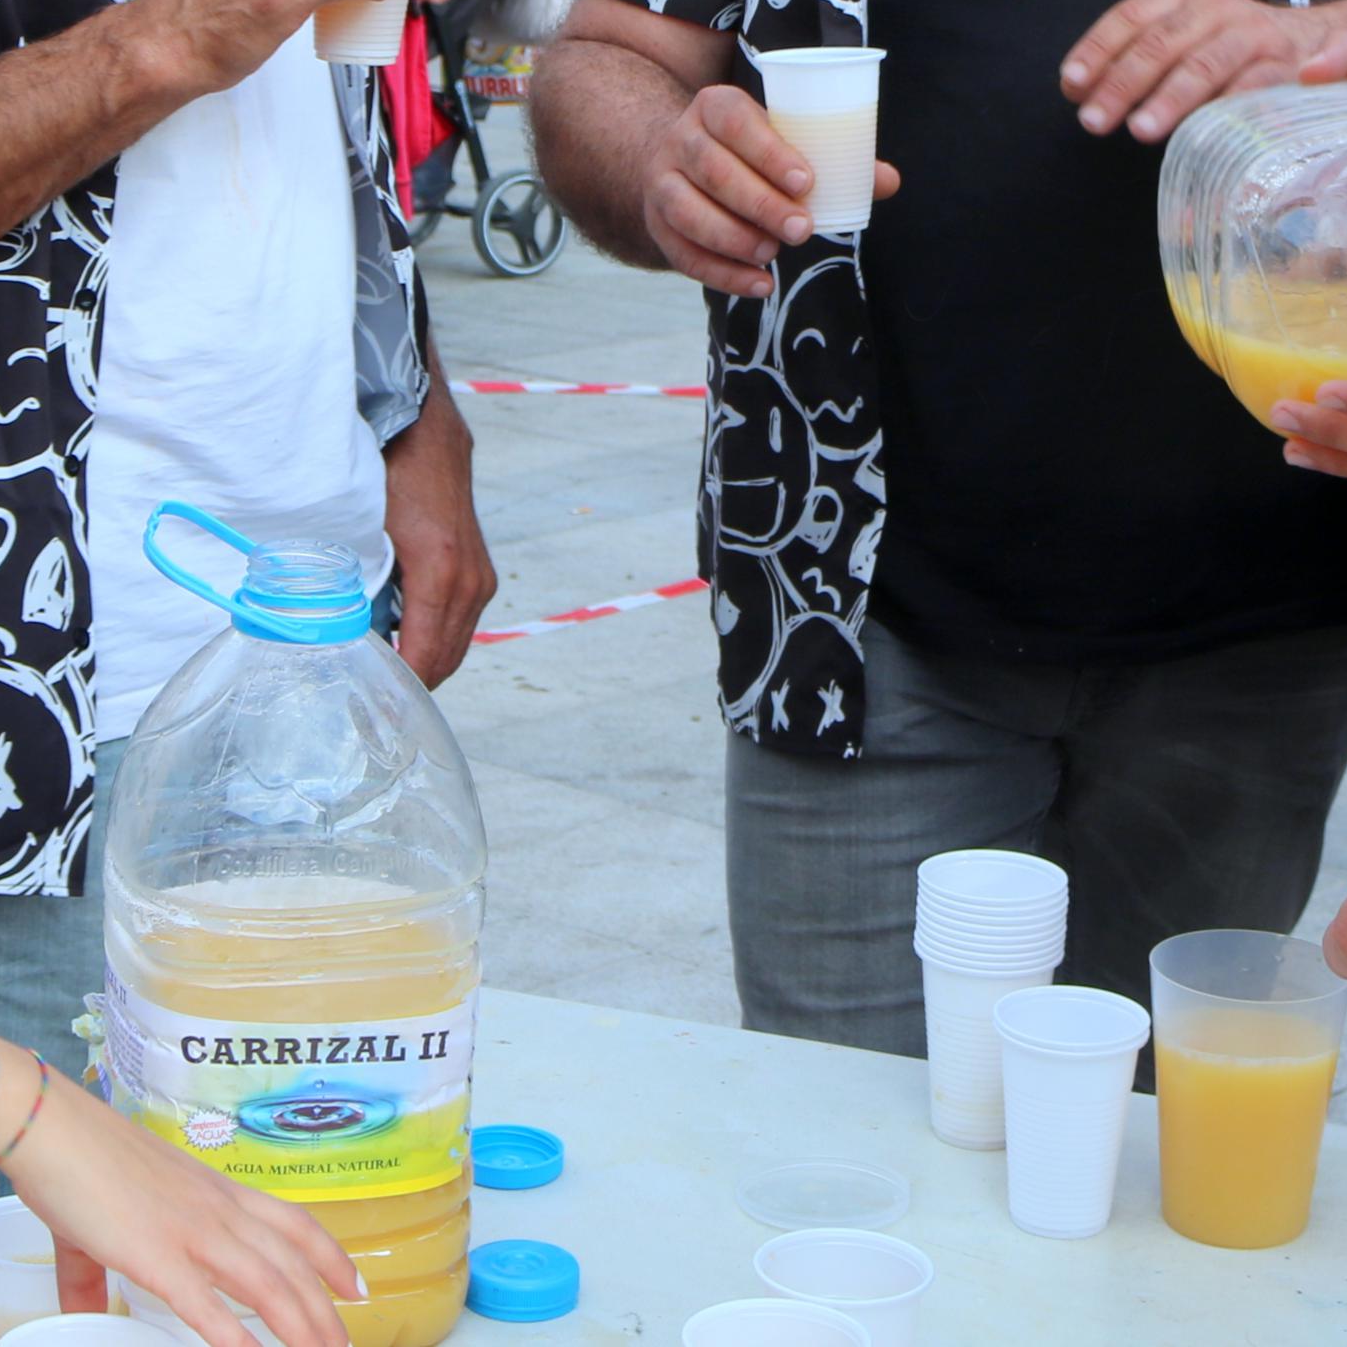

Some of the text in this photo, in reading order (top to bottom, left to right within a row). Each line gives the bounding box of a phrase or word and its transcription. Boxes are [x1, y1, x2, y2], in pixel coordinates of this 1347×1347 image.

[180, 1030, 450, 1065] CARRIZAL II
[223, 1158, 402, 1175] AGUA MINERAL NATURAL
